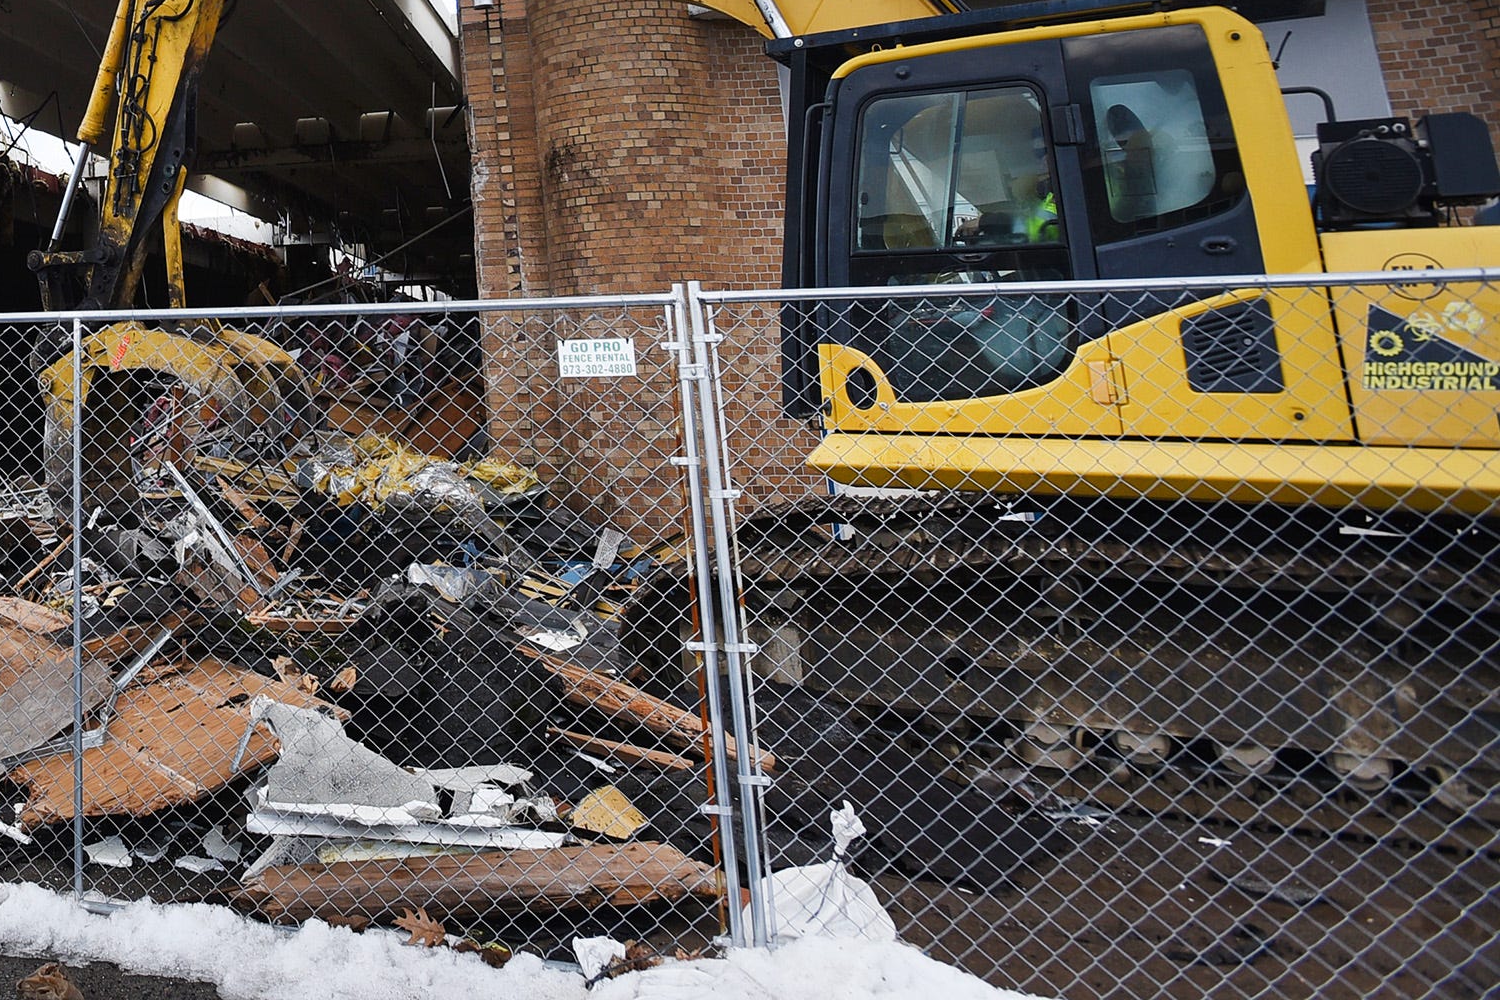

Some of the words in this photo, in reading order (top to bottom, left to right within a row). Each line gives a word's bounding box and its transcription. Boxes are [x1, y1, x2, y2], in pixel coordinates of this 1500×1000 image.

[570, 342, 588, 353] GO
[593, 341, 621, 352] PRO
[562, 354, 593, 363] FENCE
[595, 353, 630, 362] RENTAL
[562, 363, 633, 375] 973-302-4880
[1364, 361, 1499, 376] HIGHGROUND
[1364, 376, 1497, 390] INDUSTRIAL
